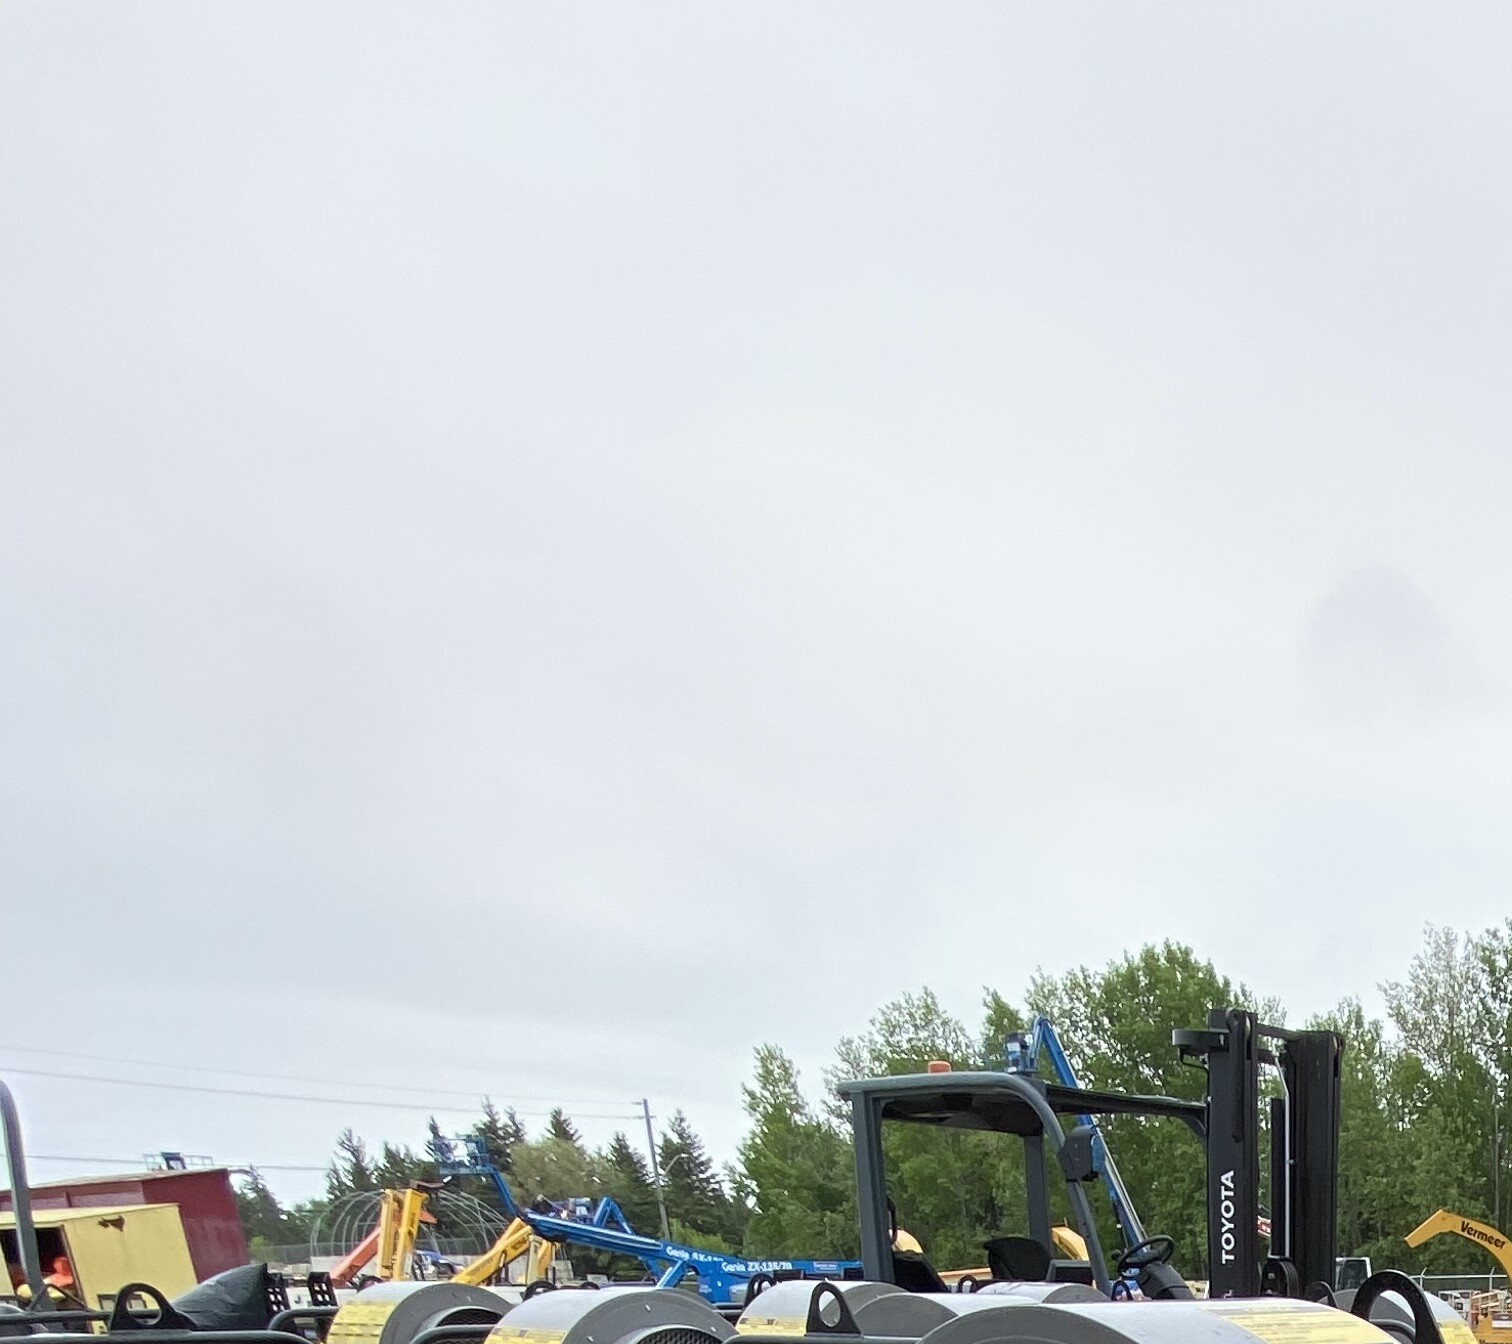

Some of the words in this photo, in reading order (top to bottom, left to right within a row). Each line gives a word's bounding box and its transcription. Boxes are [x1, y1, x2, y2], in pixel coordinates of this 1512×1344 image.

[1220, 1170, 1235, 1265] TOYOTA
[1460, 1220, 1506, 1249] Vermeer
[721, 1262, 747, 1272] Genie
